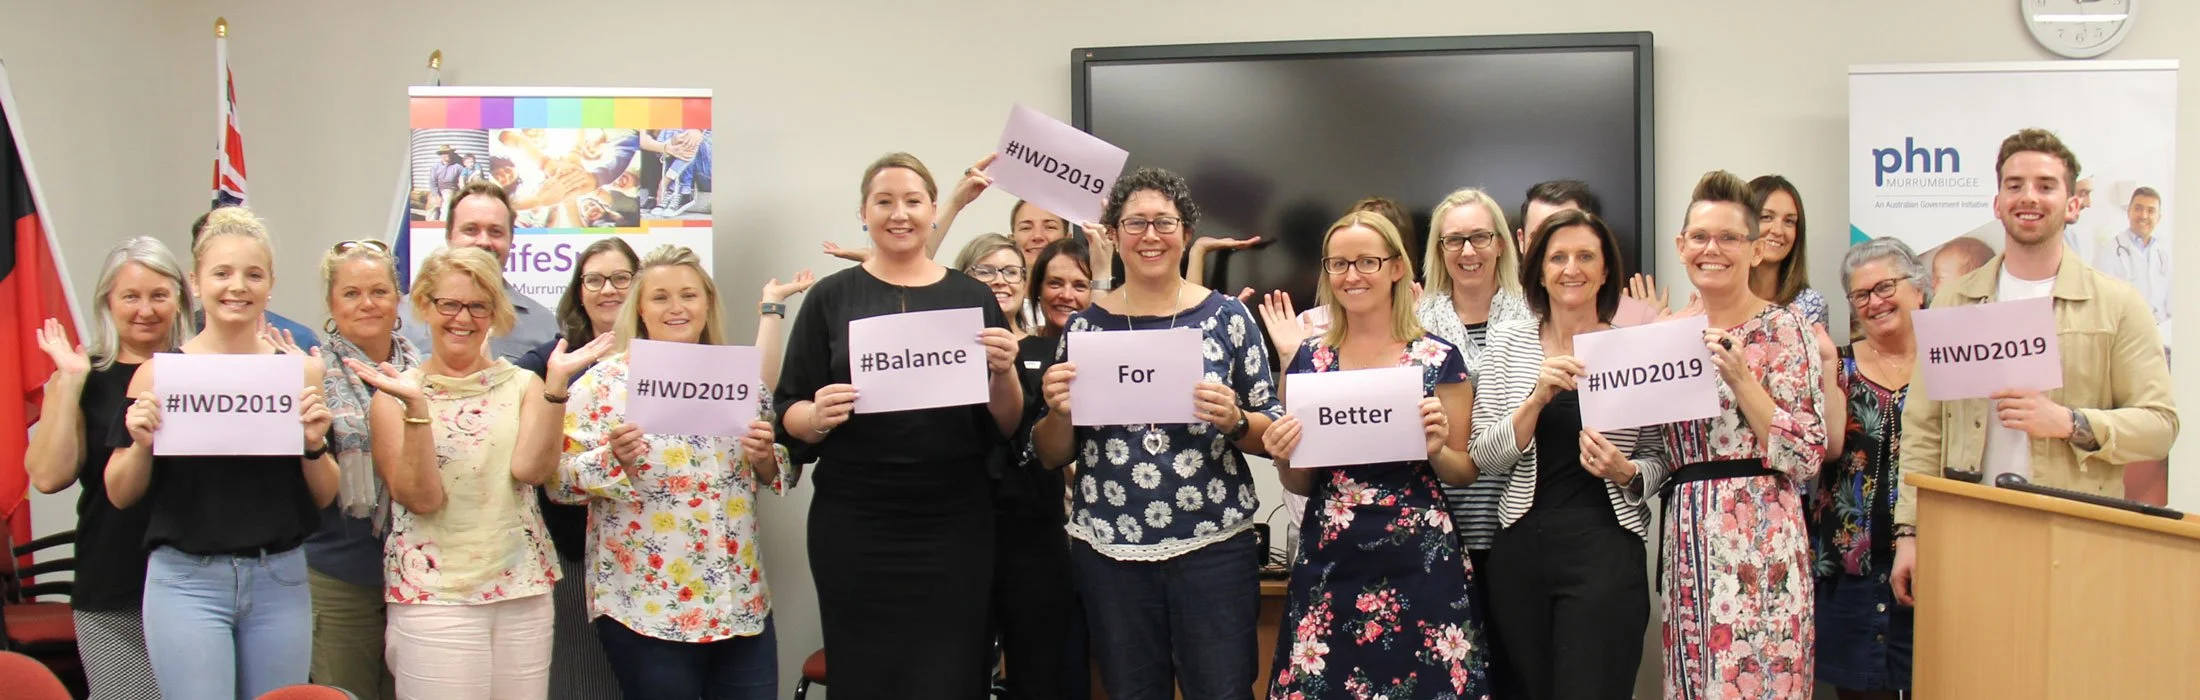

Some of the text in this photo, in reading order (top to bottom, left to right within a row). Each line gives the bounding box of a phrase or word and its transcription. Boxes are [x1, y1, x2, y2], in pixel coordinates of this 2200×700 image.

[1005, 140, 1105, 195] #IWD2019
[1872, 136, 1960, 187] phn
[1886, 178, 1980, 188] MURRUMBIDGEE
[1874, 201, 1989, 210] An Australian Government Initiative
[860, 348, 967, 373] #Balance
[1928, 336, 2047, 364] #IWD2019
[1118, 365, 1155, 384] For
[1588, 358, 1703, 393] #IWD2019
[637, 379, 749, 401] #IWD2019
[166, 394, 293, 414] #IWD2019
[1318, 406, 1393, 426] Better
